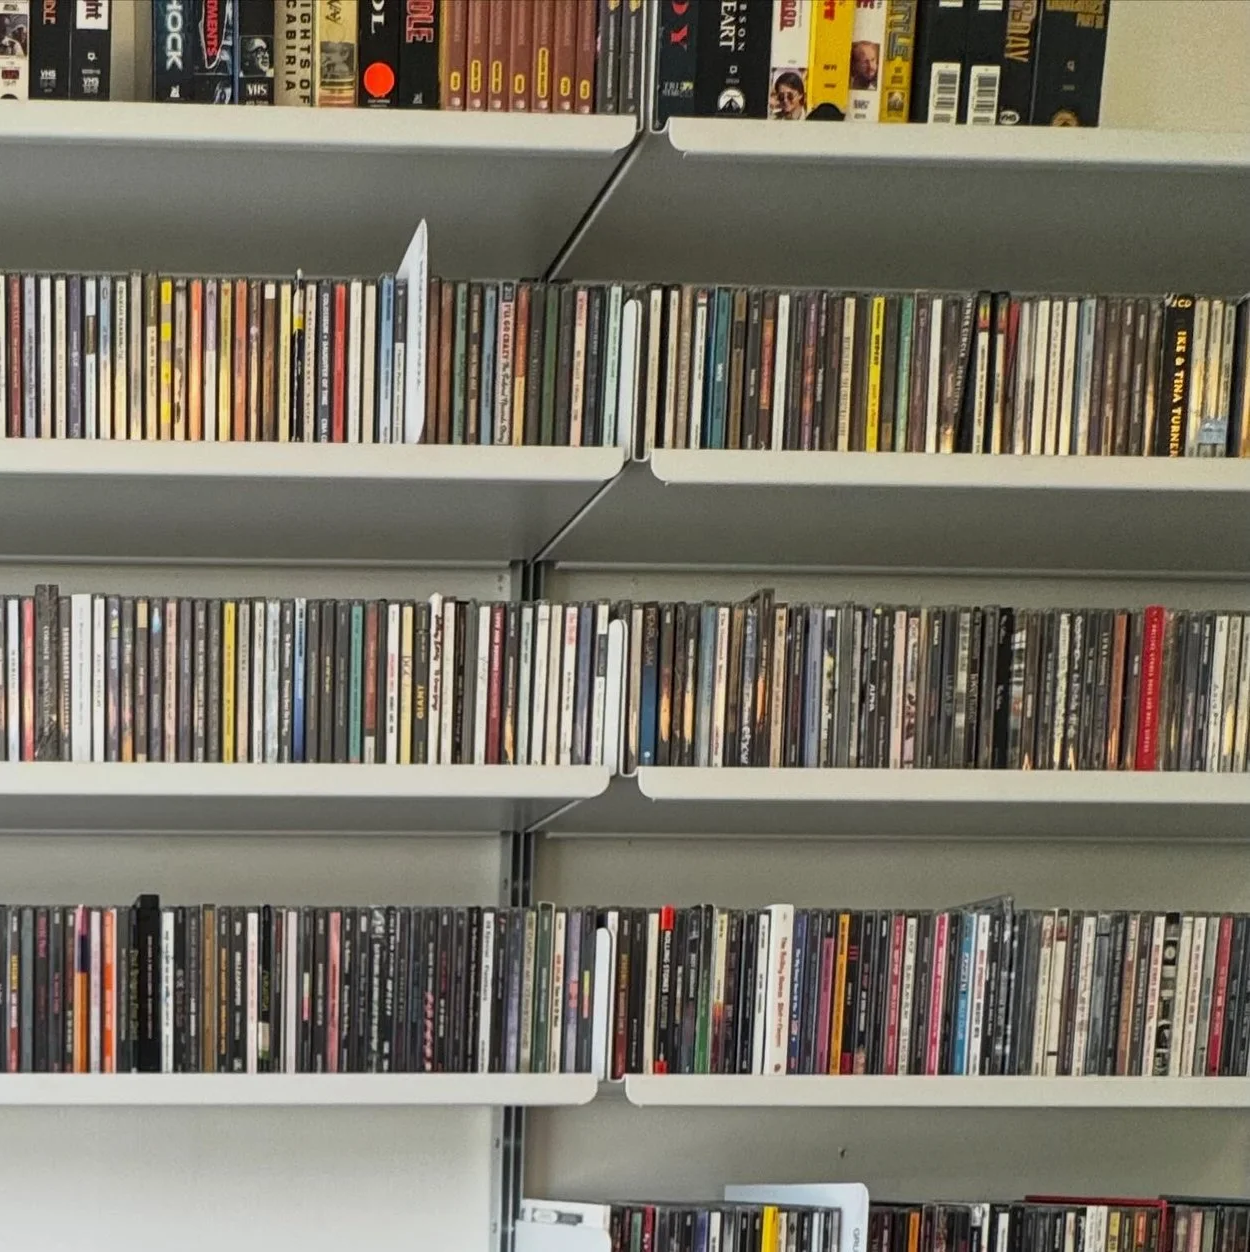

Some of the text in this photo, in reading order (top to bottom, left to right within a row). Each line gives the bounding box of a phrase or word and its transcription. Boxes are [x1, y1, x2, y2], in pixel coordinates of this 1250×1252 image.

[40, 69, 57, 79] VHS
[247, 83, 268, 96] VHS
[299, 78, 310, 105] OF
[503, 304, 512, 319] I'LL
[503, 320, 511, 332] GO
[502, 333, 511, 359] CRAZY
[1169, 330, 1187, 457] IKE & TINA TURNER
[417, 683, 425, 720] GIANT
[741, 726, 752, 765] elbow
[662, 930, 671, 994] ROLLING STONES
